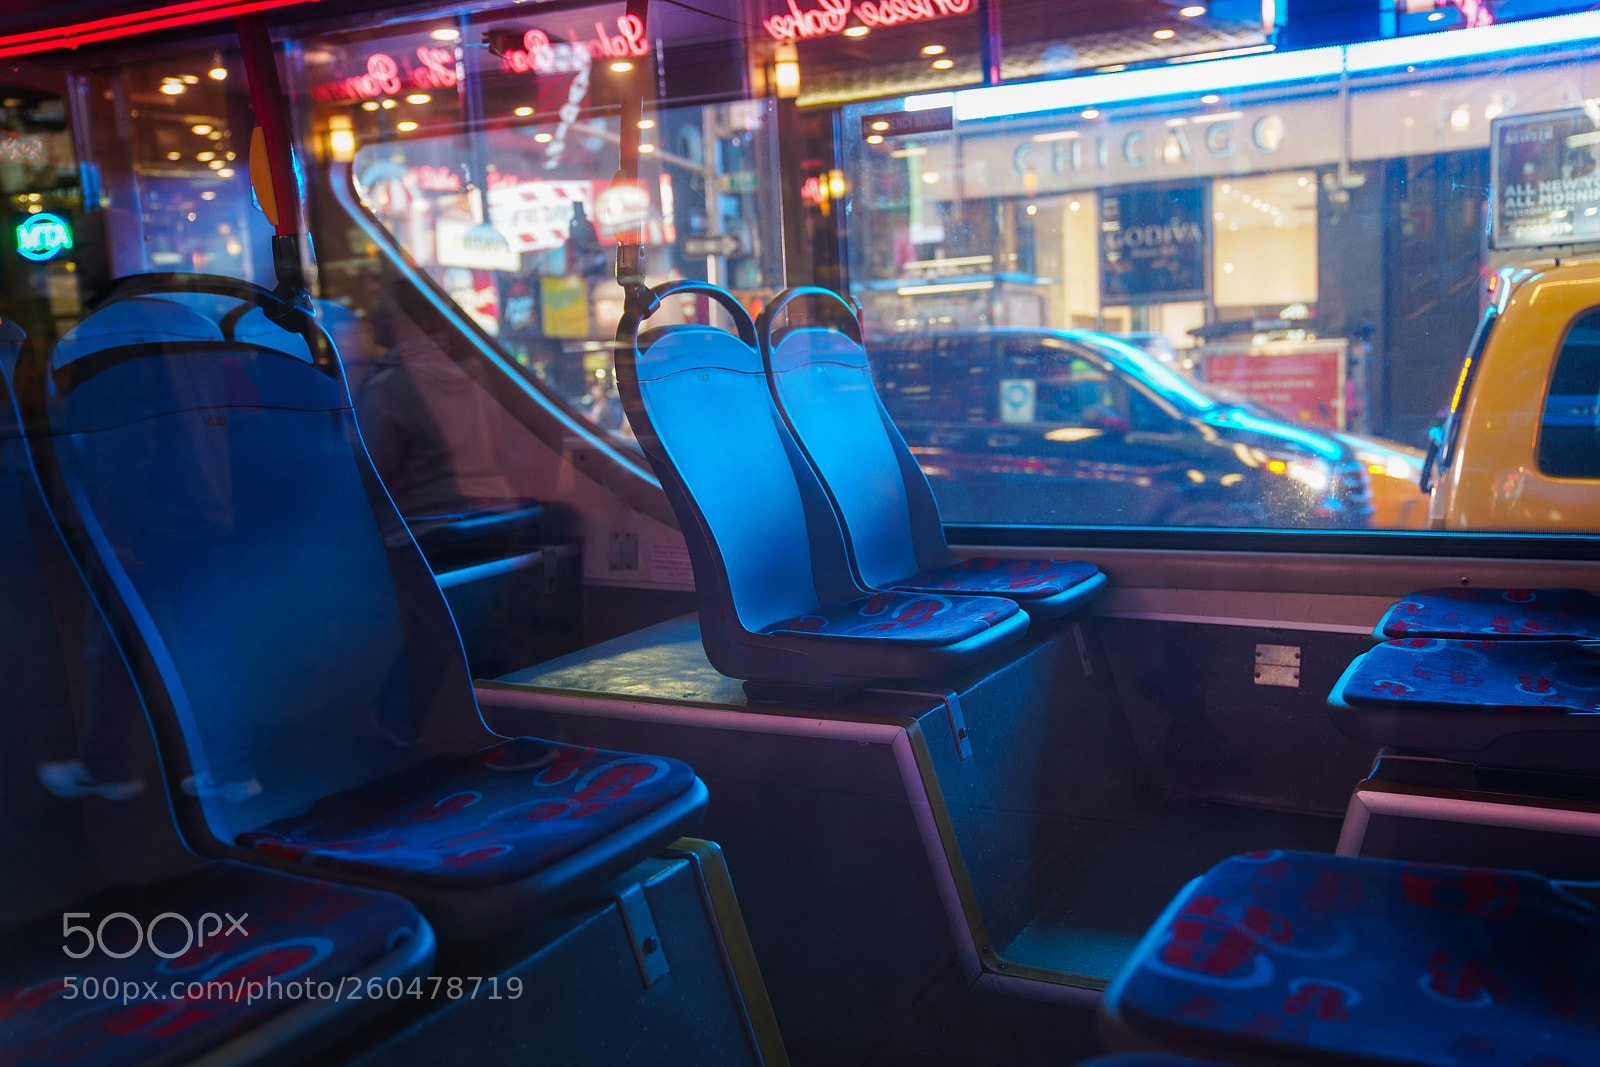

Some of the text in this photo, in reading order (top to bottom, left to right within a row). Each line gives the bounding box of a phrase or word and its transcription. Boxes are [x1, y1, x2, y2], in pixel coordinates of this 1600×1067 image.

[863, 115, 914, 133] EENCY
[1012, 114, 1285, 175] CHICAGO
[1505, 183, 1536, 198] ALL
[1538, 178, 1576, 192] NEW
[1504, 196, 1536, 209] ALL
[16, 221, 74, 252] MTA
[1104, 222, 1203, 252] GODIVA
